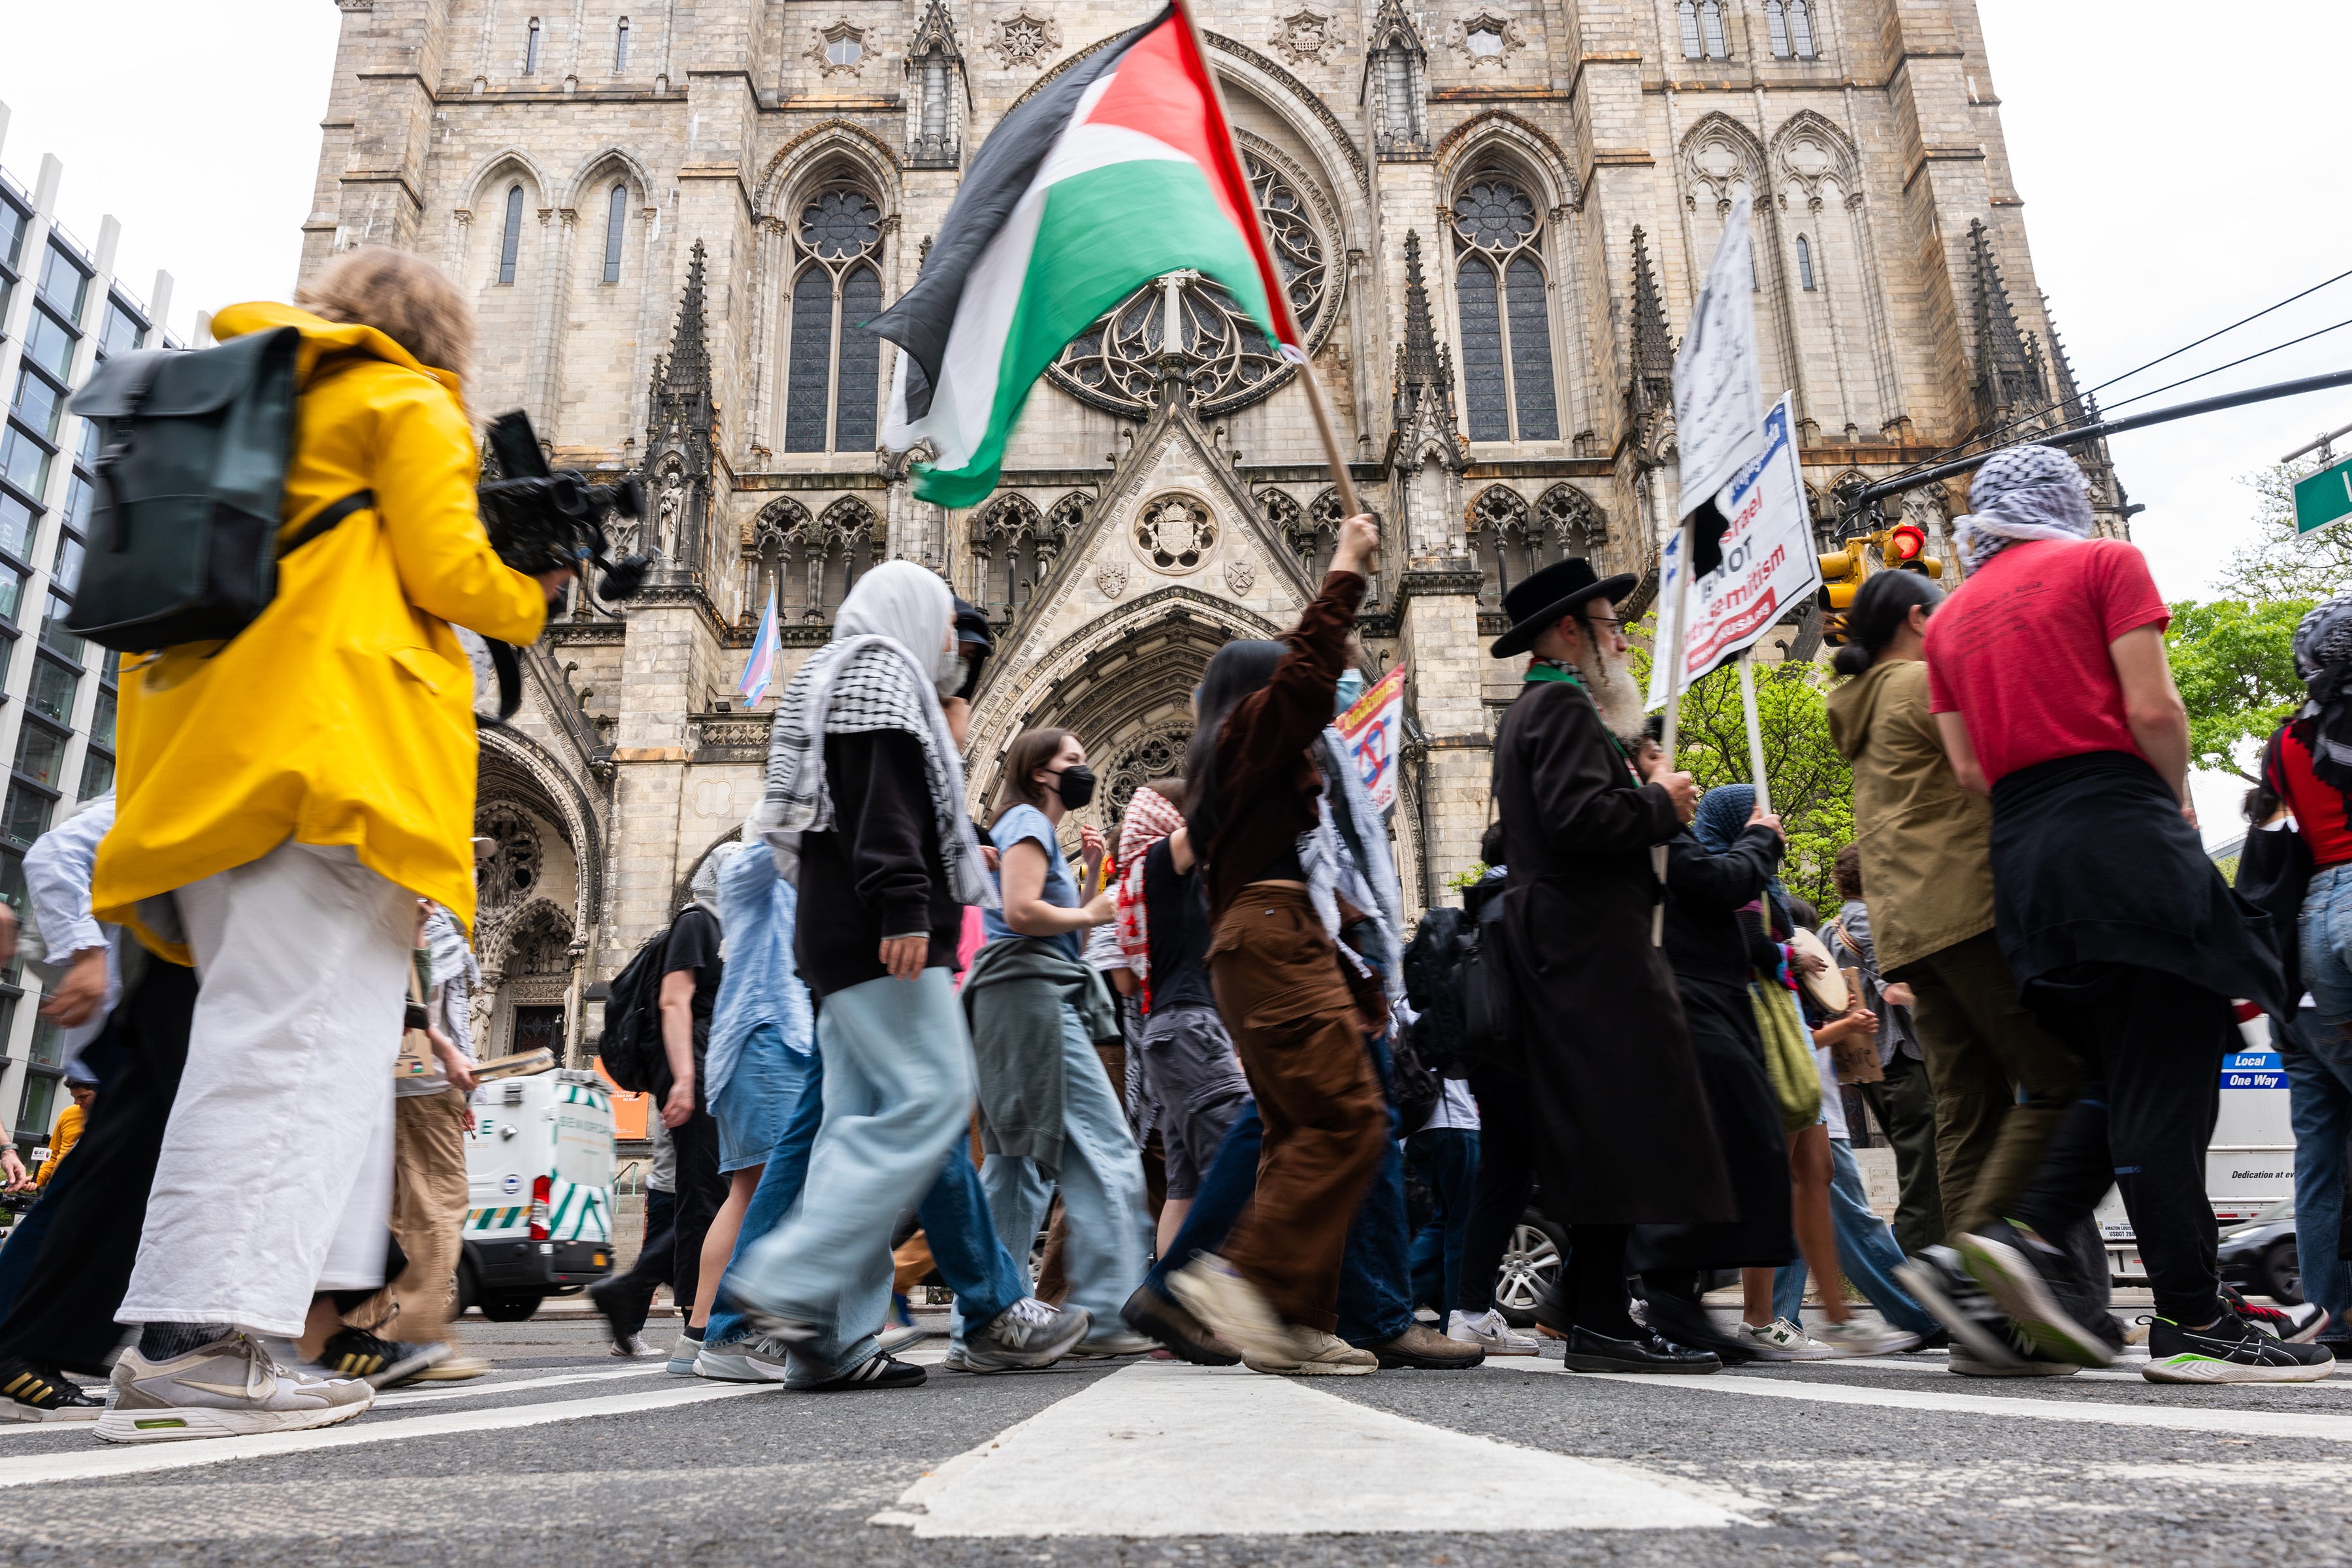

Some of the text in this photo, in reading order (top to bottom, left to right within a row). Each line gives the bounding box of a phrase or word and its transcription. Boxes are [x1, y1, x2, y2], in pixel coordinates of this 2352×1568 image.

[1720, 485, 1762, 544] srael
[2235, 1055, 2266, 1066] Local
[2230, 1074, 2278, 1088] One Way
